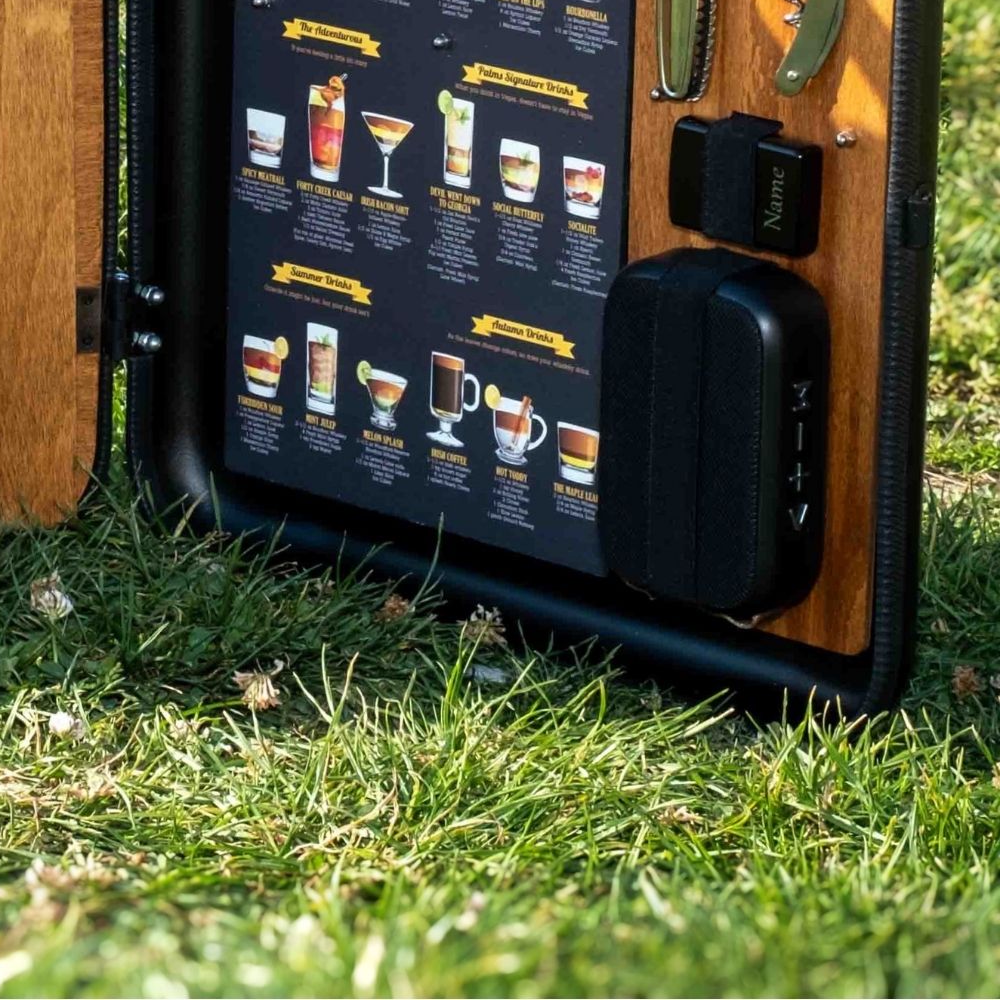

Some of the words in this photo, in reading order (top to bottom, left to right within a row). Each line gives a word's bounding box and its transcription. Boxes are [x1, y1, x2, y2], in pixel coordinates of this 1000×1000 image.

[299, 21, 313, 34] The
[314, 25, 364, 45] Adventurous
[477, 65, 504, 80] Palms
[504, 71, 544, 90] Signature
[545, 81, 574, 97] Drinks
[430, 186, 446, 198] DEVIL
[447, 190, 463, 203] WENT
[464, 194, 481, 206] DOWN
[439, 198, 447, 209] TO
[763, 166, 785, 231] Name
[290, 266, 323, 283] Summer
[325, 275, 352, 291] Drinks
[491, 320, 524, 337] Autumn
[525, 327, 554, 344] Drinks
